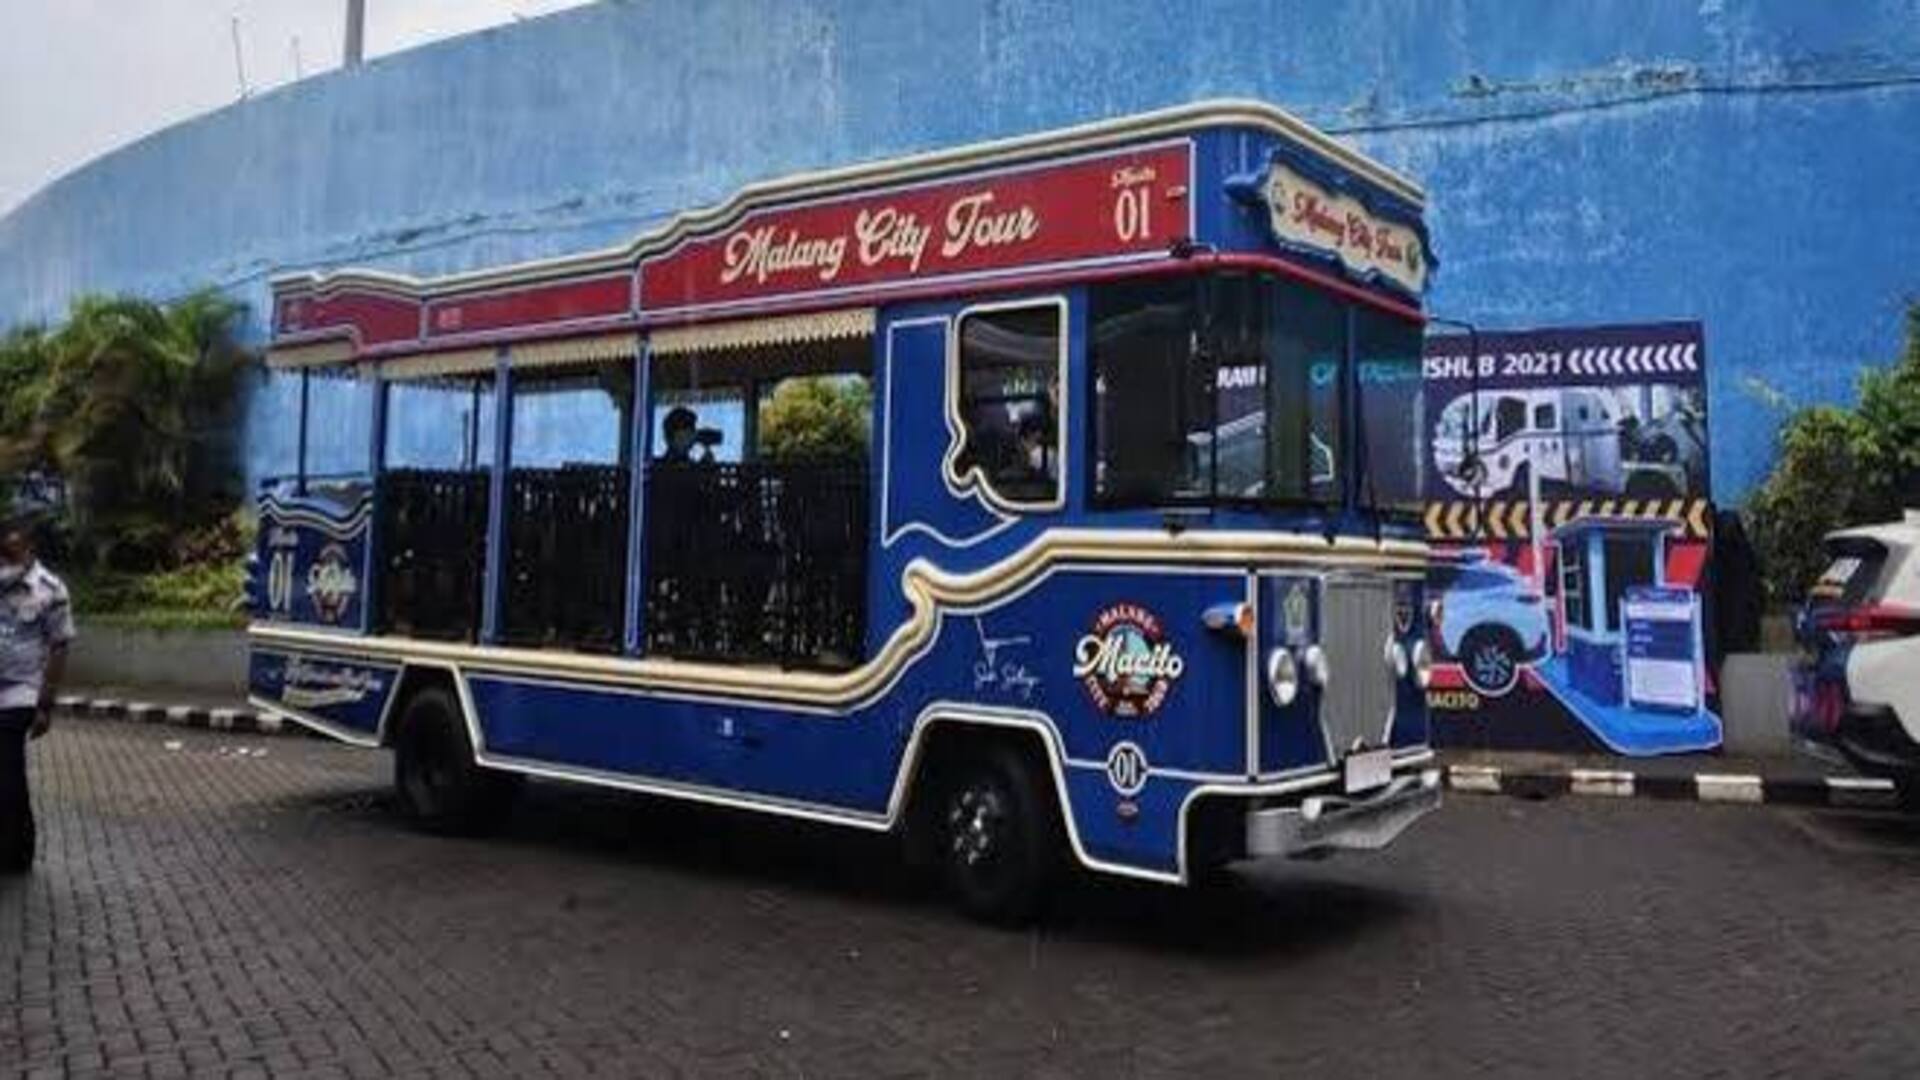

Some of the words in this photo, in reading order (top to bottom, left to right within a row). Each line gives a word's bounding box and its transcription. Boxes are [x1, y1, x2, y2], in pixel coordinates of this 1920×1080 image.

[720, 227, 846, 284] Malang
[855, 205, 930, 271] City
[940, 192, 1038, 258] Tour
[1114, 187, 1150, 241] 01
[1501, 352, 1563, 375] 2021
[268, 551, 294, 611] 01
[1073, 633, 1184, 684] Macito
[1113, 752, 1138, 786] 01
